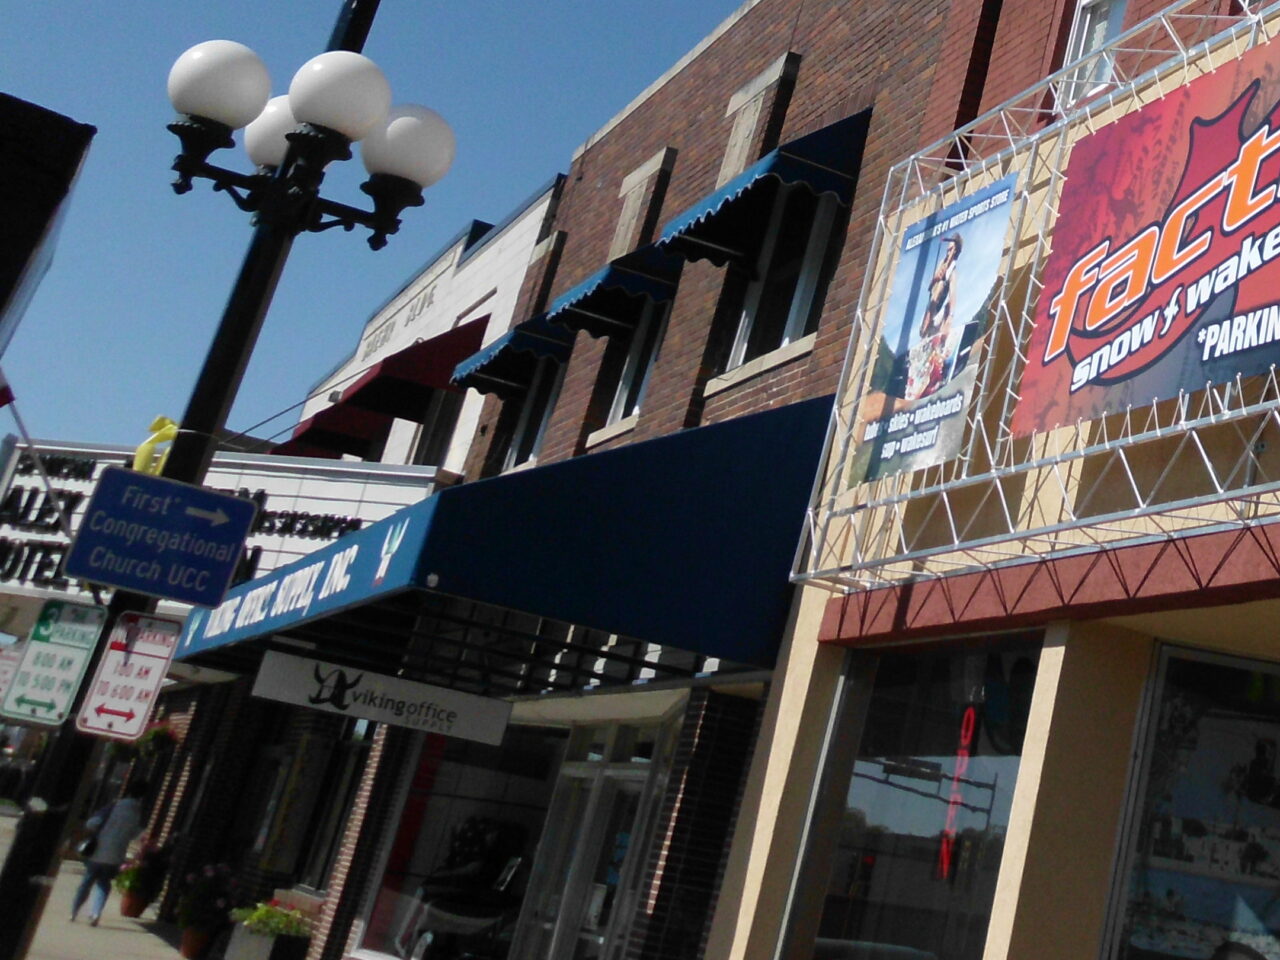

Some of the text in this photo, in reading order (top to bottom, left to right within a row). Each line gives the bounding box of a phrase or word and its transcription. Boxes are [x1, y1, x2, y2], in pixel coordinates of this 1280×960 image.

[1071, 316, 1159, 392] snow
[121, 486, 173, 515] First
[90, 510, 235, 562] Congregational
[89, 546, 162, 581] Church
[168, 563, 211, 591] UCC
[405, 716, 455, 732] SUPPLY
